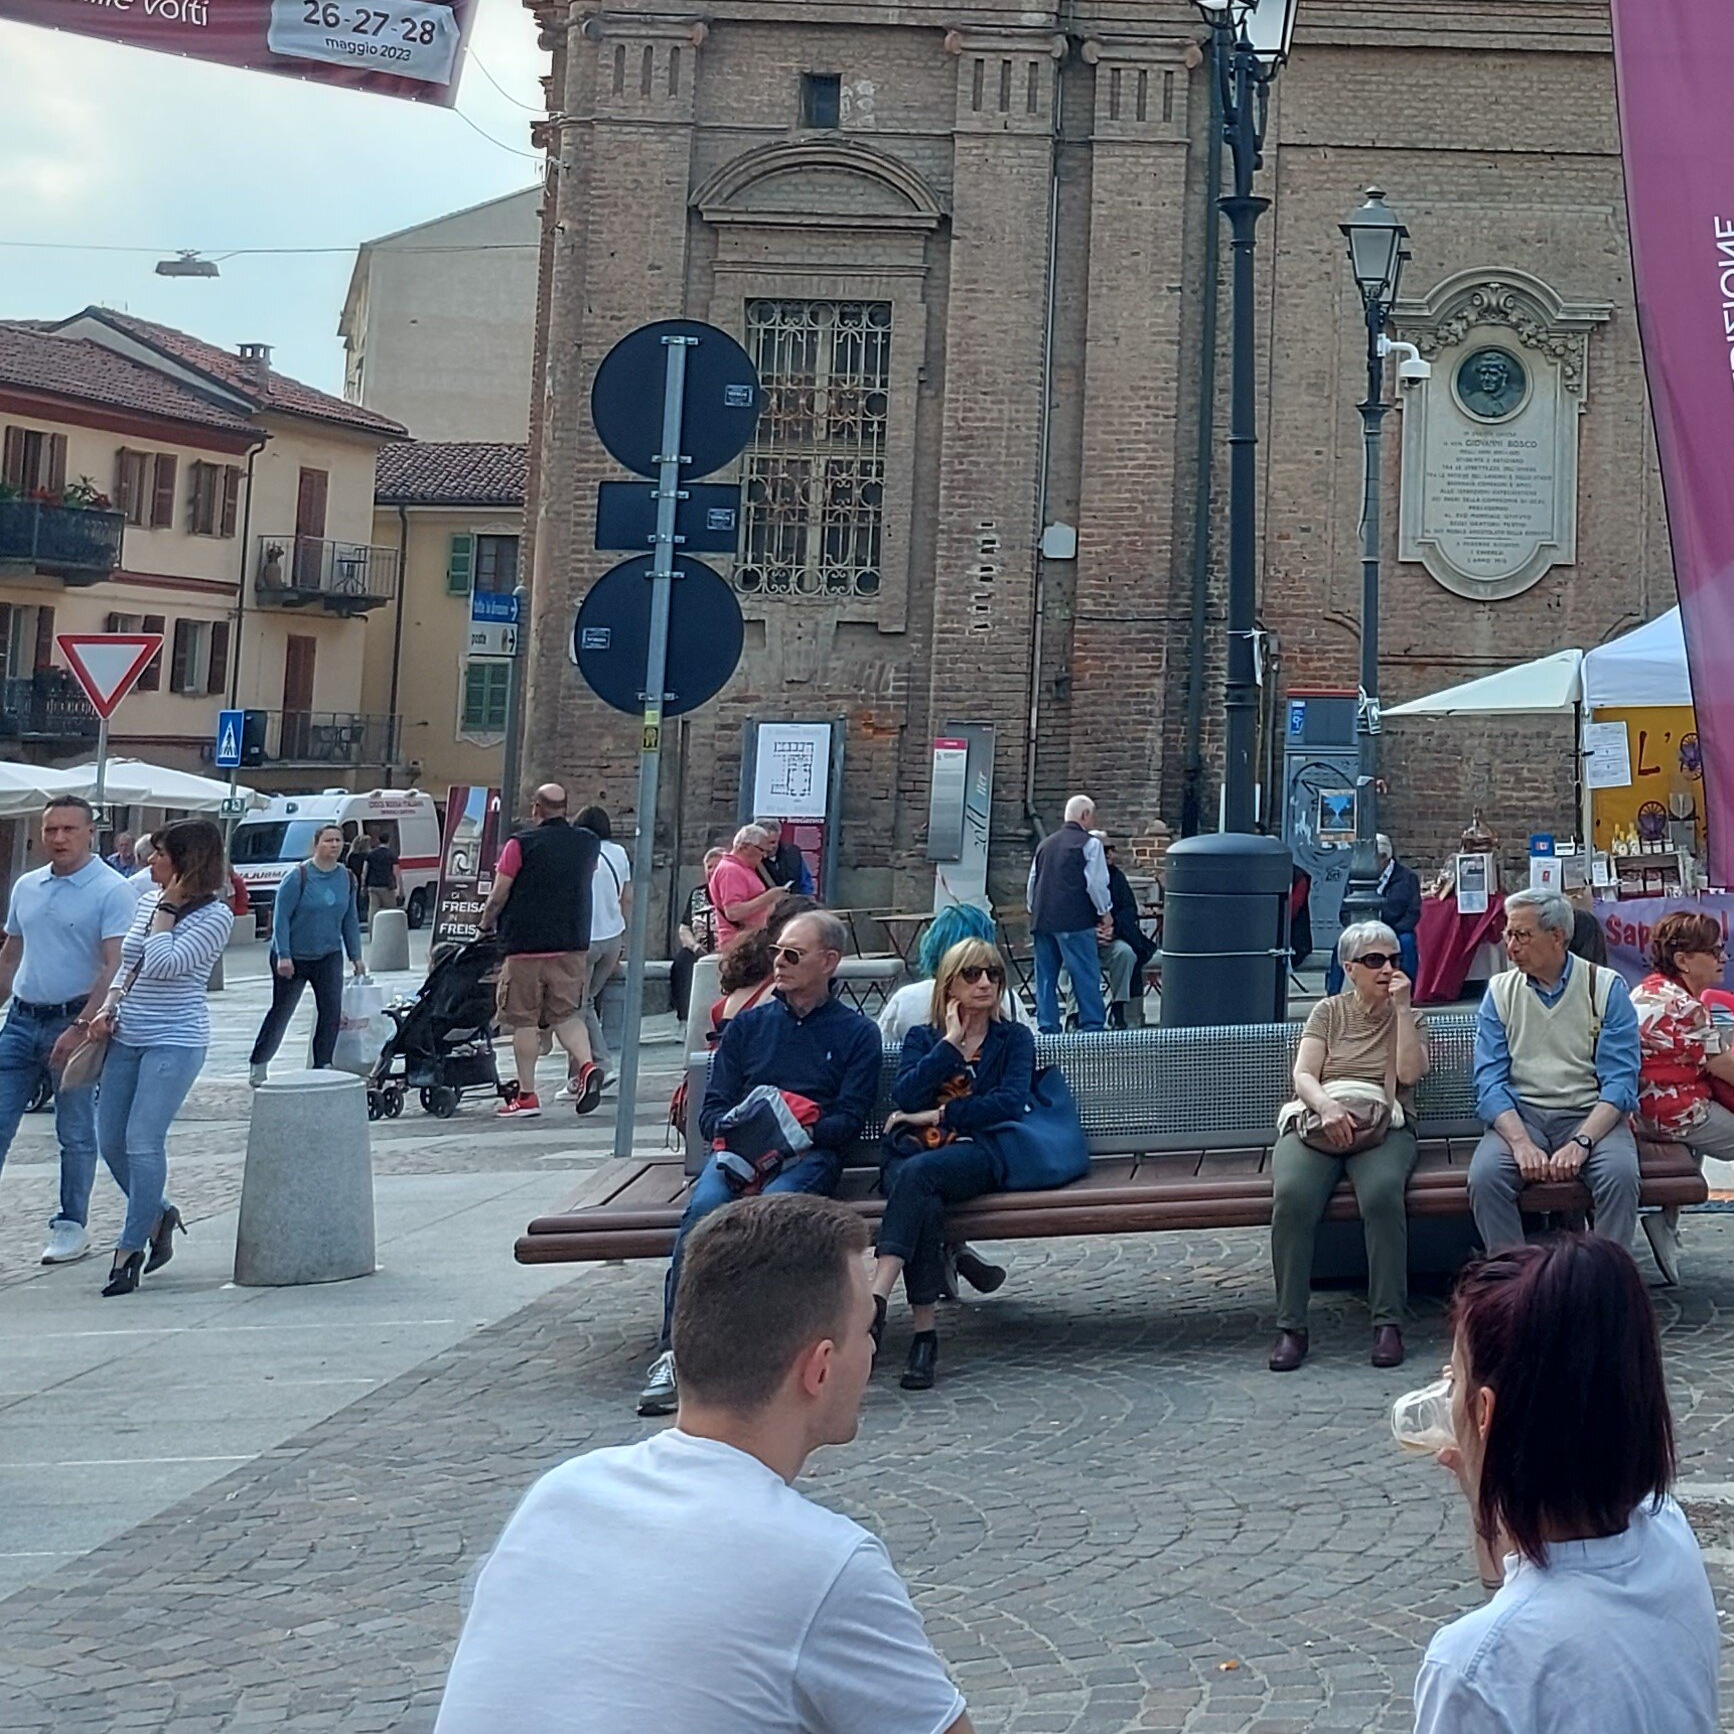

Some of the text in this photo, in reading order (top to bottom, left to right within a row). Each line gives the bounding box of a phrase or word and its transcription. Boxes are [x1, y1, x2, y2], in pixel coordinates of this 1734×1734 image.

[325, 35, 412, 63] maggio 2023
[1508, 440, 1538, 448] BOSCO
[439, 922, 478, 935] FREIS
